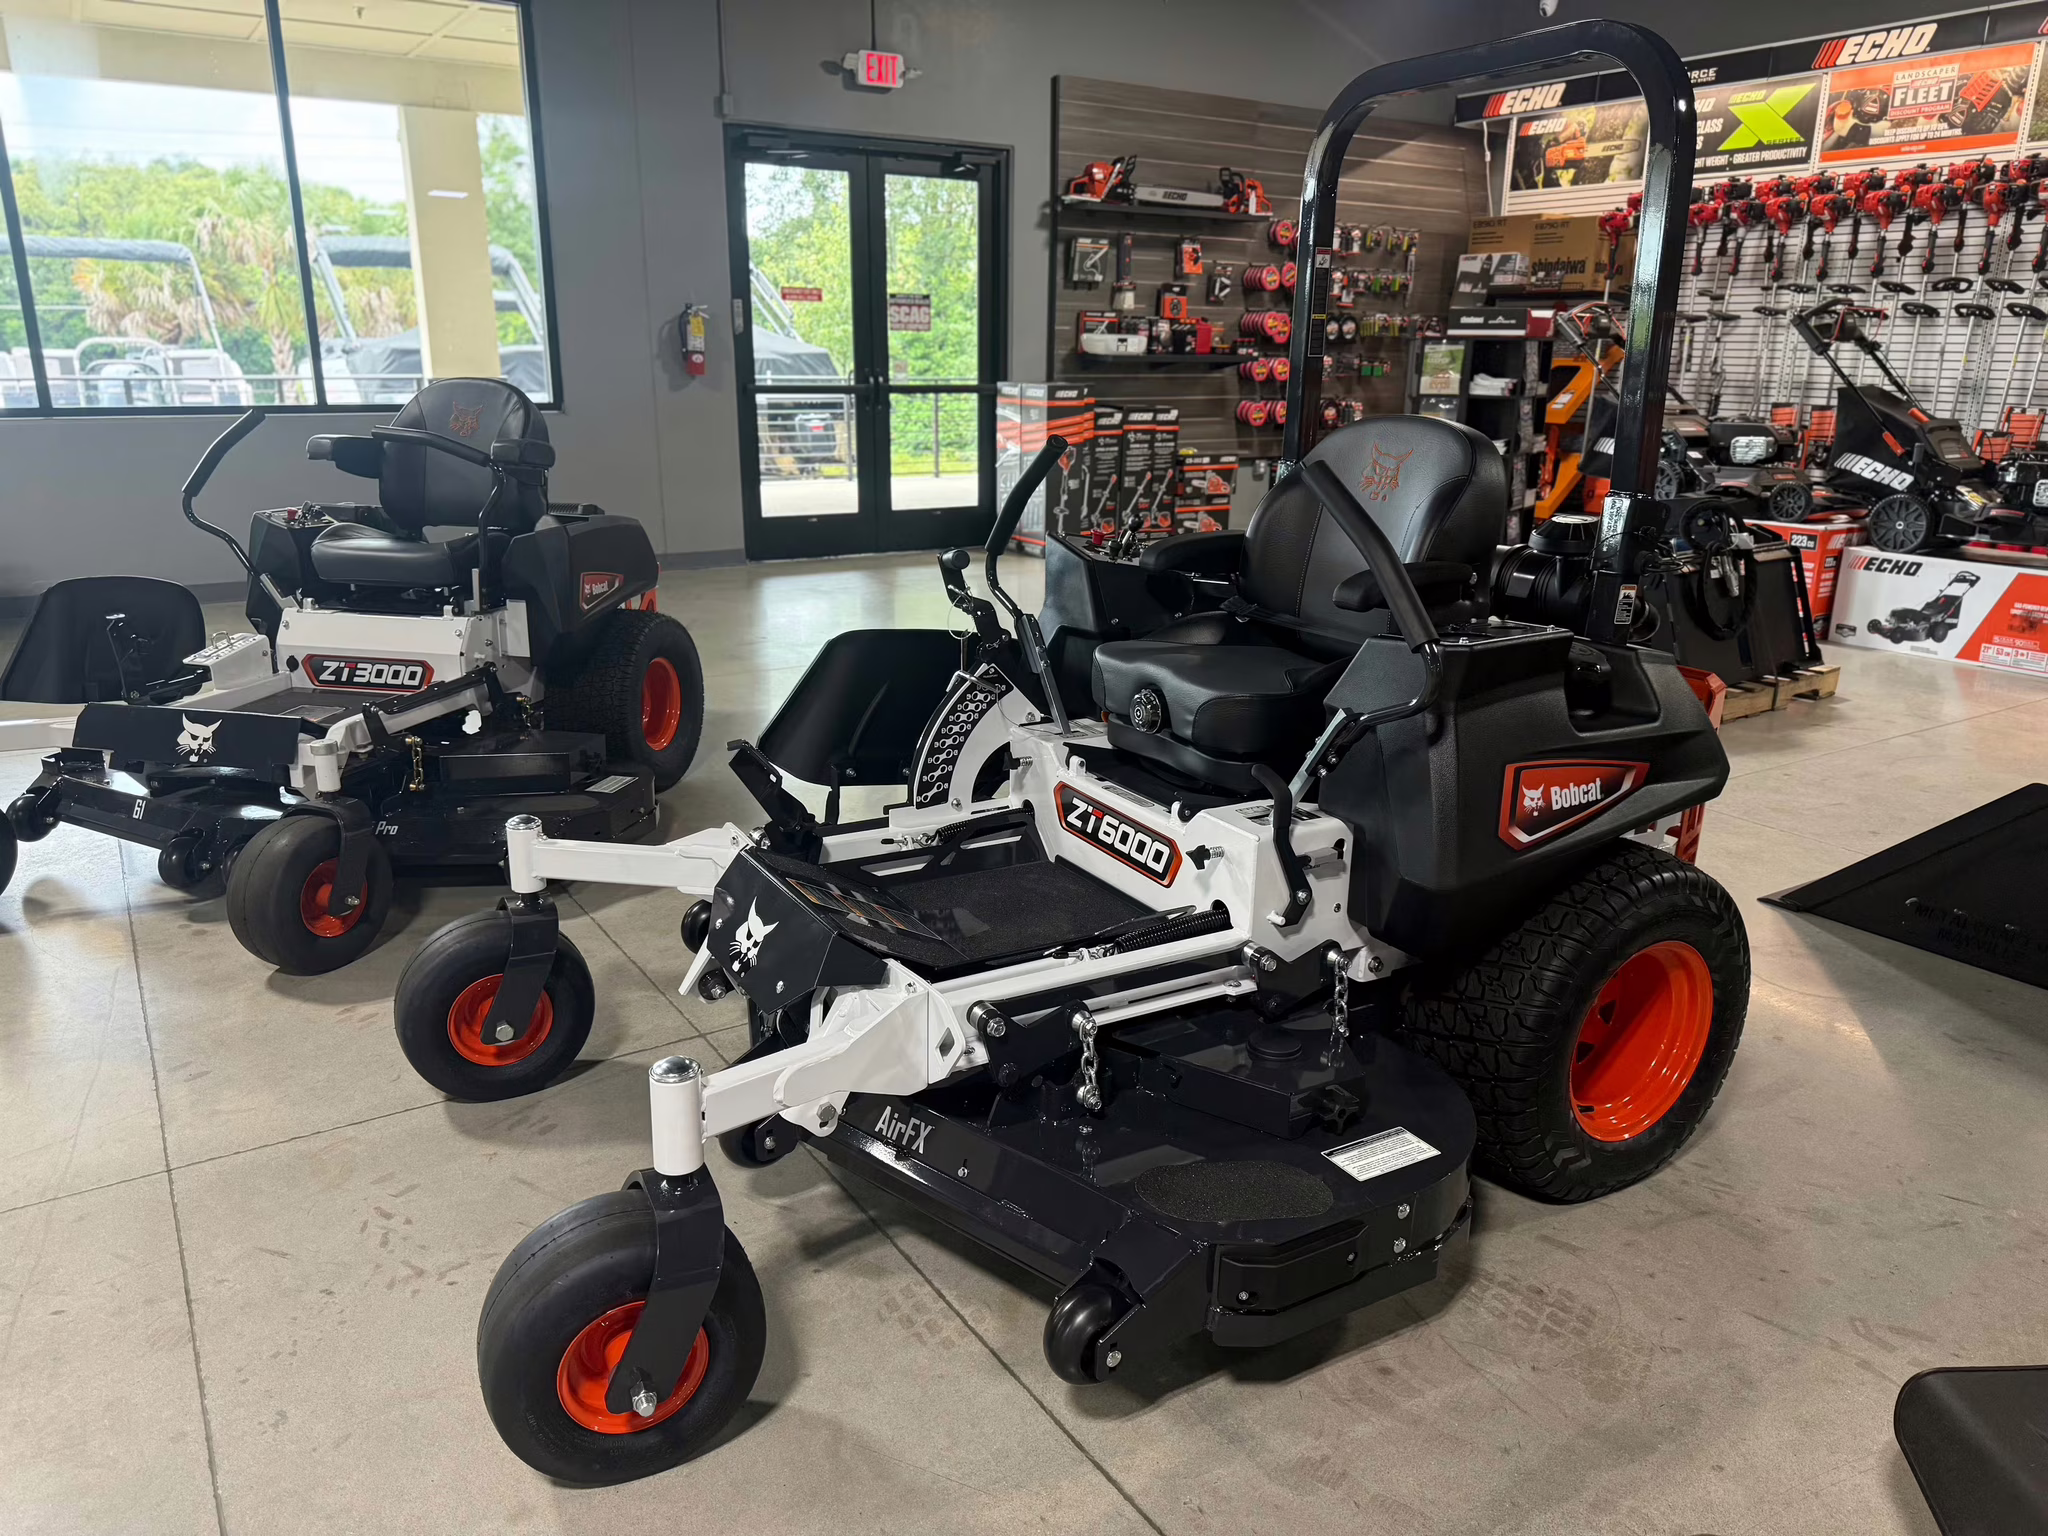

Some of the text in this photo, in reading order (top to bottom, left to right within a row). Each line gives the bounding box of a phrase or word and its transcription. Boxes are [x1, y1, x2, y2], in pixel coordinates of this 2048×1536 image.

[1835, 23, 1938, 65] ECHO
[866, 52, 898, 87] EXIT
[1688, 67, 1718, 79] RCE
[1896, 66, 1956, 80] LANDSCAPER
[1499, 83, 1566, 115] ECHO
[1893, 81, 1953, 107] FLEET
[1890, 104, 1950, 116] DISCOUNT PROGRAM
[1529, 117, 1568, 136] ECHO
[1733, 152, 1760, 164] GREATER
[1761, 147, 1808, 161] PRODUCTIVITY
[889, 305, 930, 324] SCAG
[1851, 456, 1914, 491] ECHO
[1791, 534, 1808, 547] 223
[1863, 557, 1924, 577] ECHO
[319, 661, 423, 686] ZT3000
[1550, 777, 1602, 811] Bobcat
[133, 798, 146, 820] 61
[375, 821, 399, 835] Pro
[1066, 797, 1170, 873] ZT6000
[874, 1105, 933, 1154] AirFX
